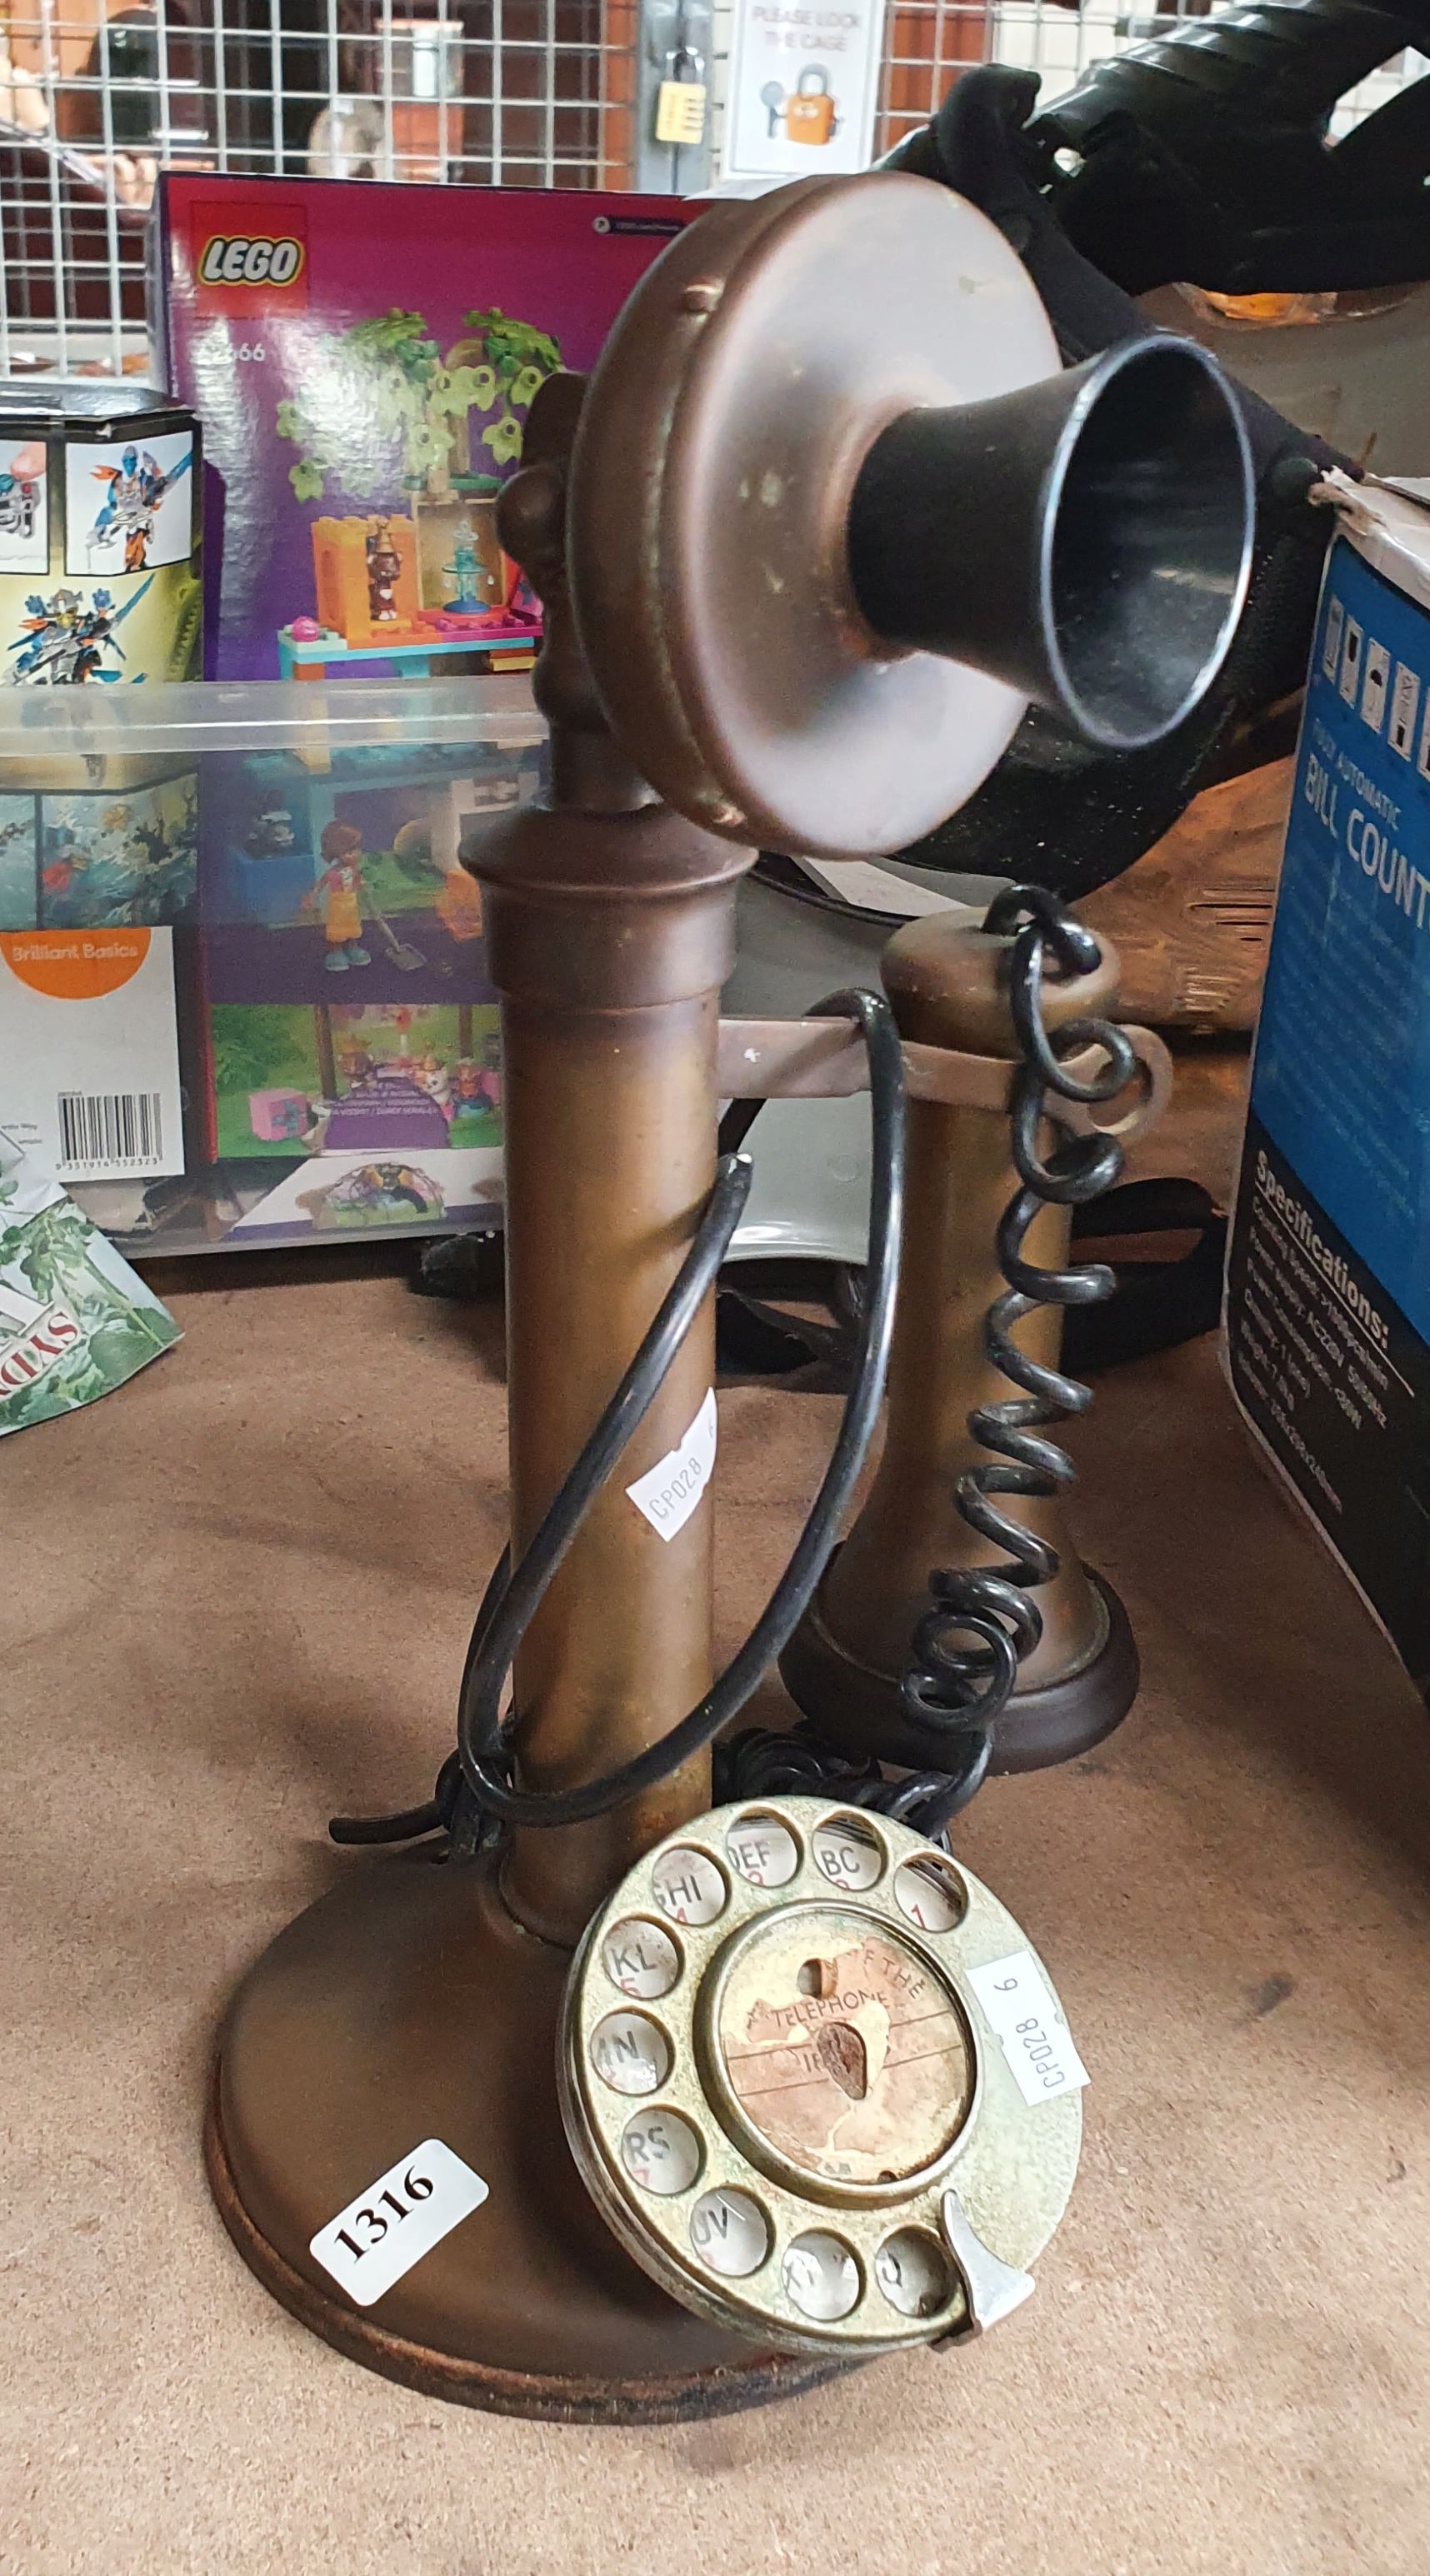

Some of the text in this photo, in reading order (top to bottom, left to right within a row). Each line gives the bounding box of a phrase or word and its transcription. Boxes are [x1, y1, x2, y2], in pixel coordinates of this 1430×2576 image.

[201, 237, 301, 283] LEGO
[1305, 752, 1338, 840] BILL
[12, 942, 138, 961] Brilliant Basics
[1257, 1150, 1390, 1350] Specifications:
[649, 1457, 702, 1520] CP028
[821, 1846, 861, 1876] BC
[882, 1957, 926, 1999] THE
[772, 1988, 891, 2029] TELEPHONE
[993, 1977, 1066, 2089] CP028 6
[627, 2125, 671, 2163] RS
[334, 2164, 434, 2264] 1316
